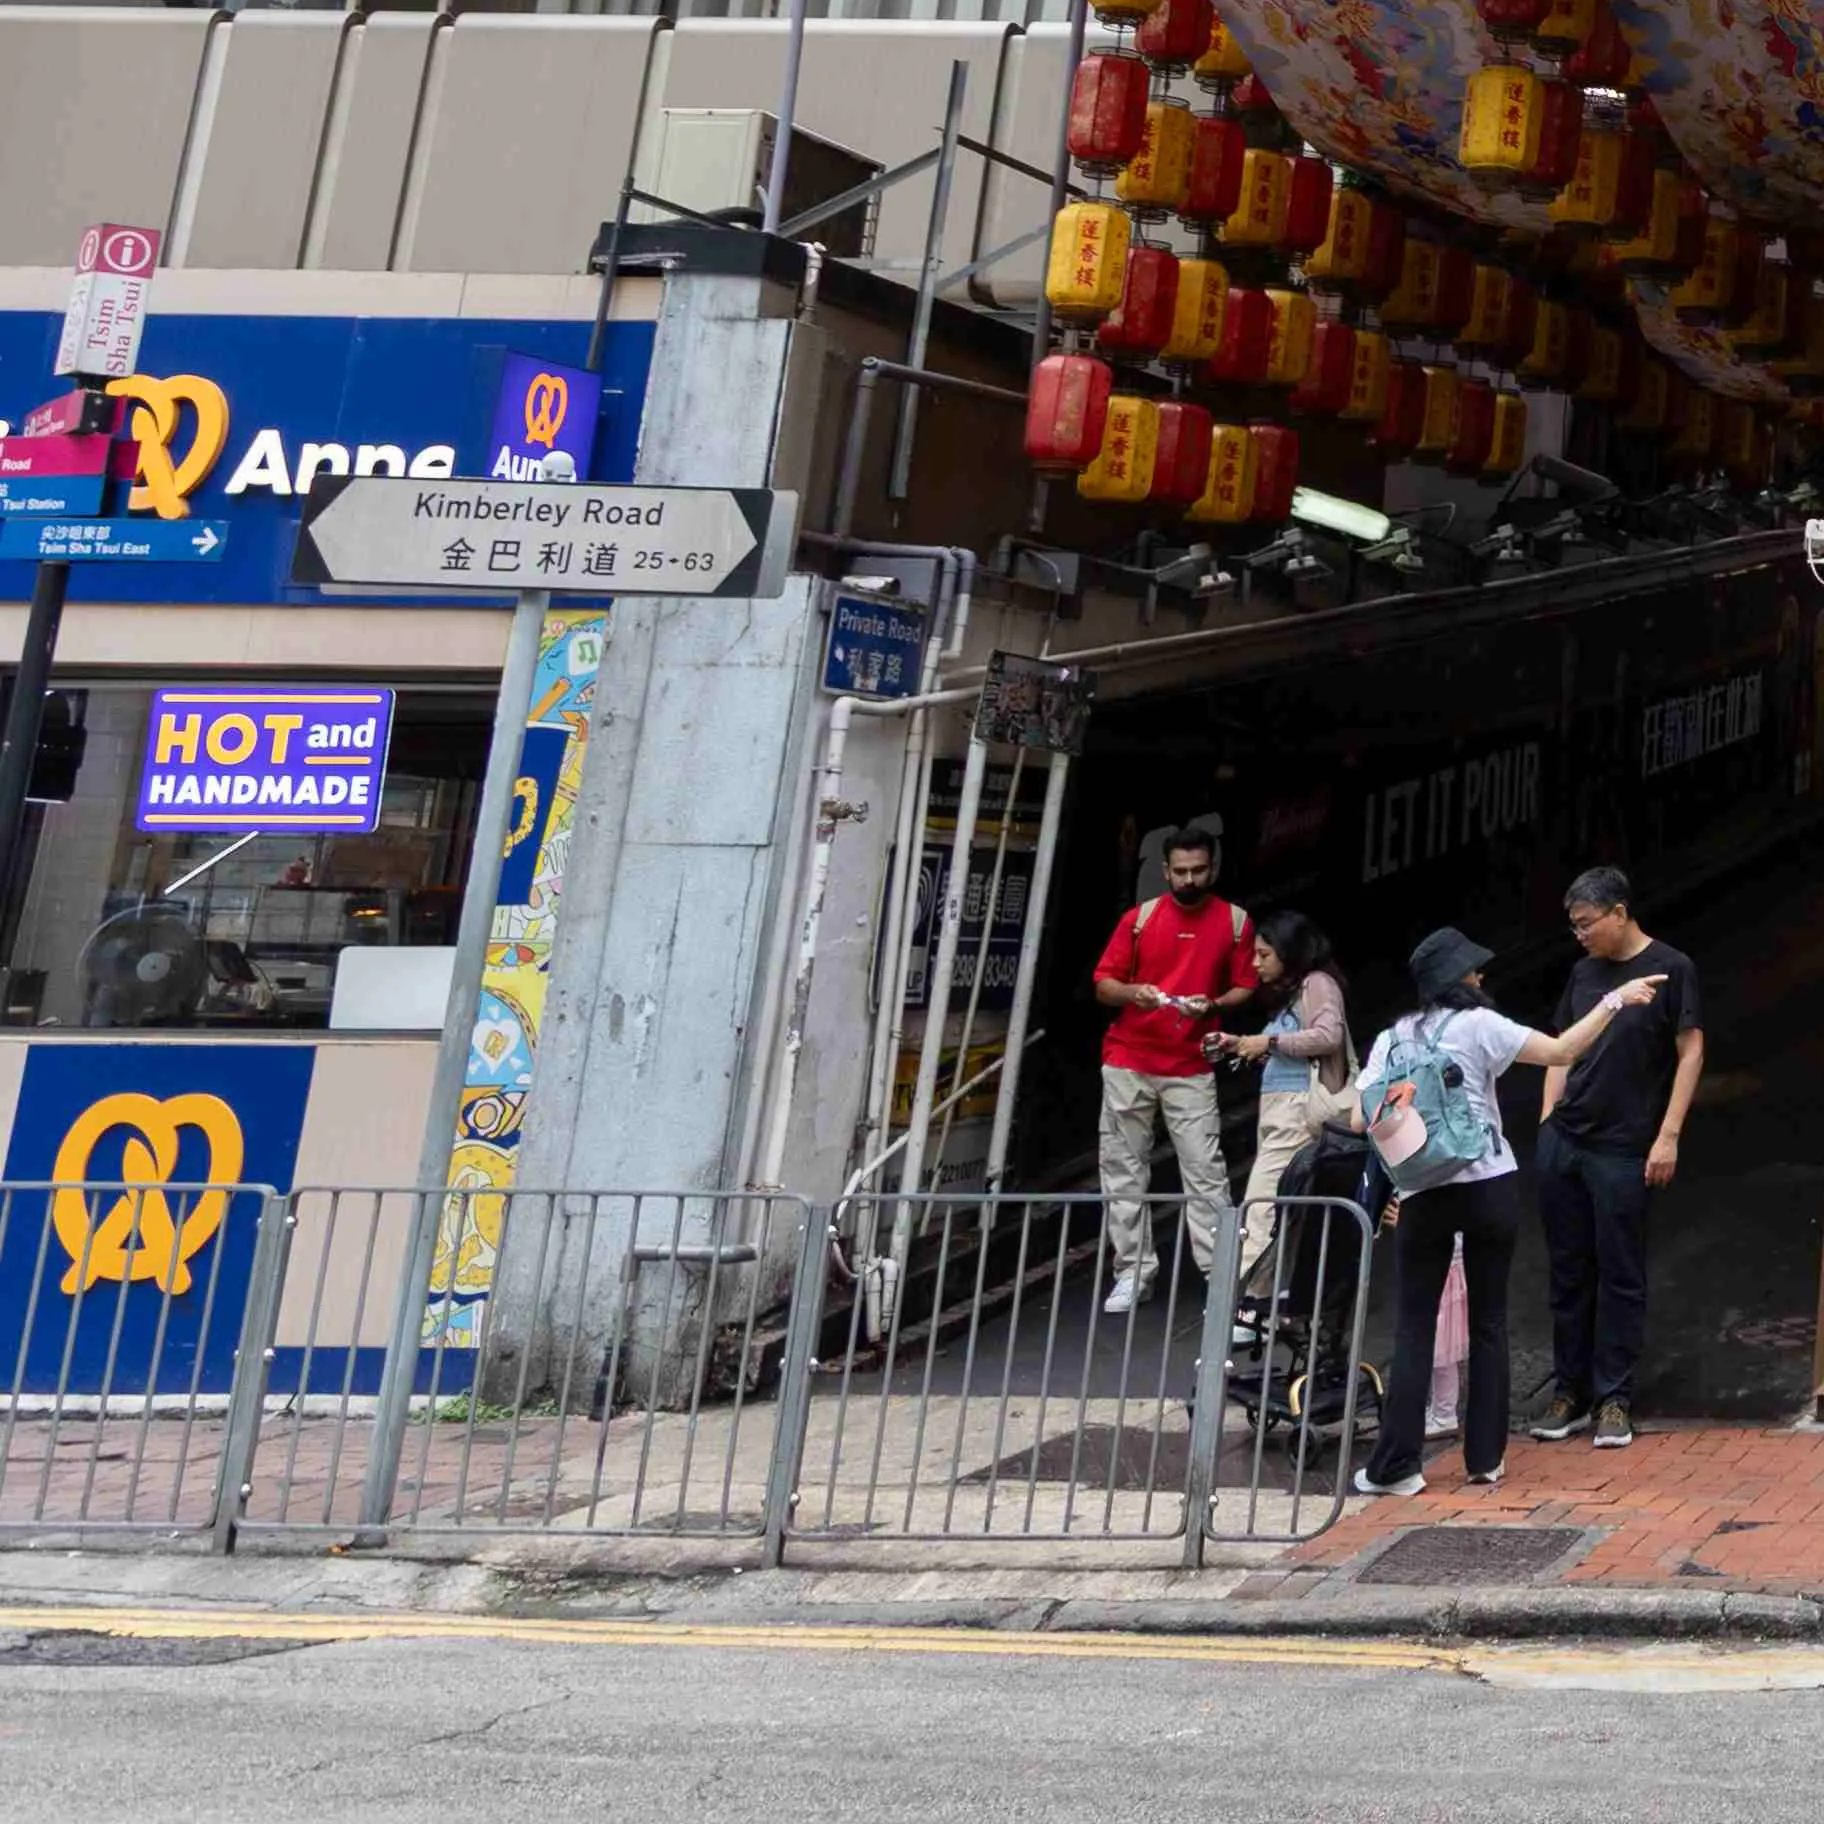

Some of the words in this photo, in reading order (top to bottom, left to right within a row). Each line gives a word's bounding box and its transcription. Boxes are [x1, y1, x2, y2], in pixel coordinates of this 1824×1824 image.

[88, 298, 115, 349] Tsim
[115, 280, 142, 331] Tsui
[106, 334, 131, 376] Sha
[413, 491, 569, 527] Kimberley
[585, 498, 664, 527] Road
[441, 537, 618, 577] 金巴利道
[839, 608, 885, 637] Private
[887, 617, 921, 643] Road
[155, 714, 303, 765] HOT
[307, 716, 376, 749] and
[148, 774, 370, 807] HANDMADE
[1362, 780, 1421, 882] LET
[1426, 769, 1455, 858] IT
[1461, 741, 1540, 845] POUR
